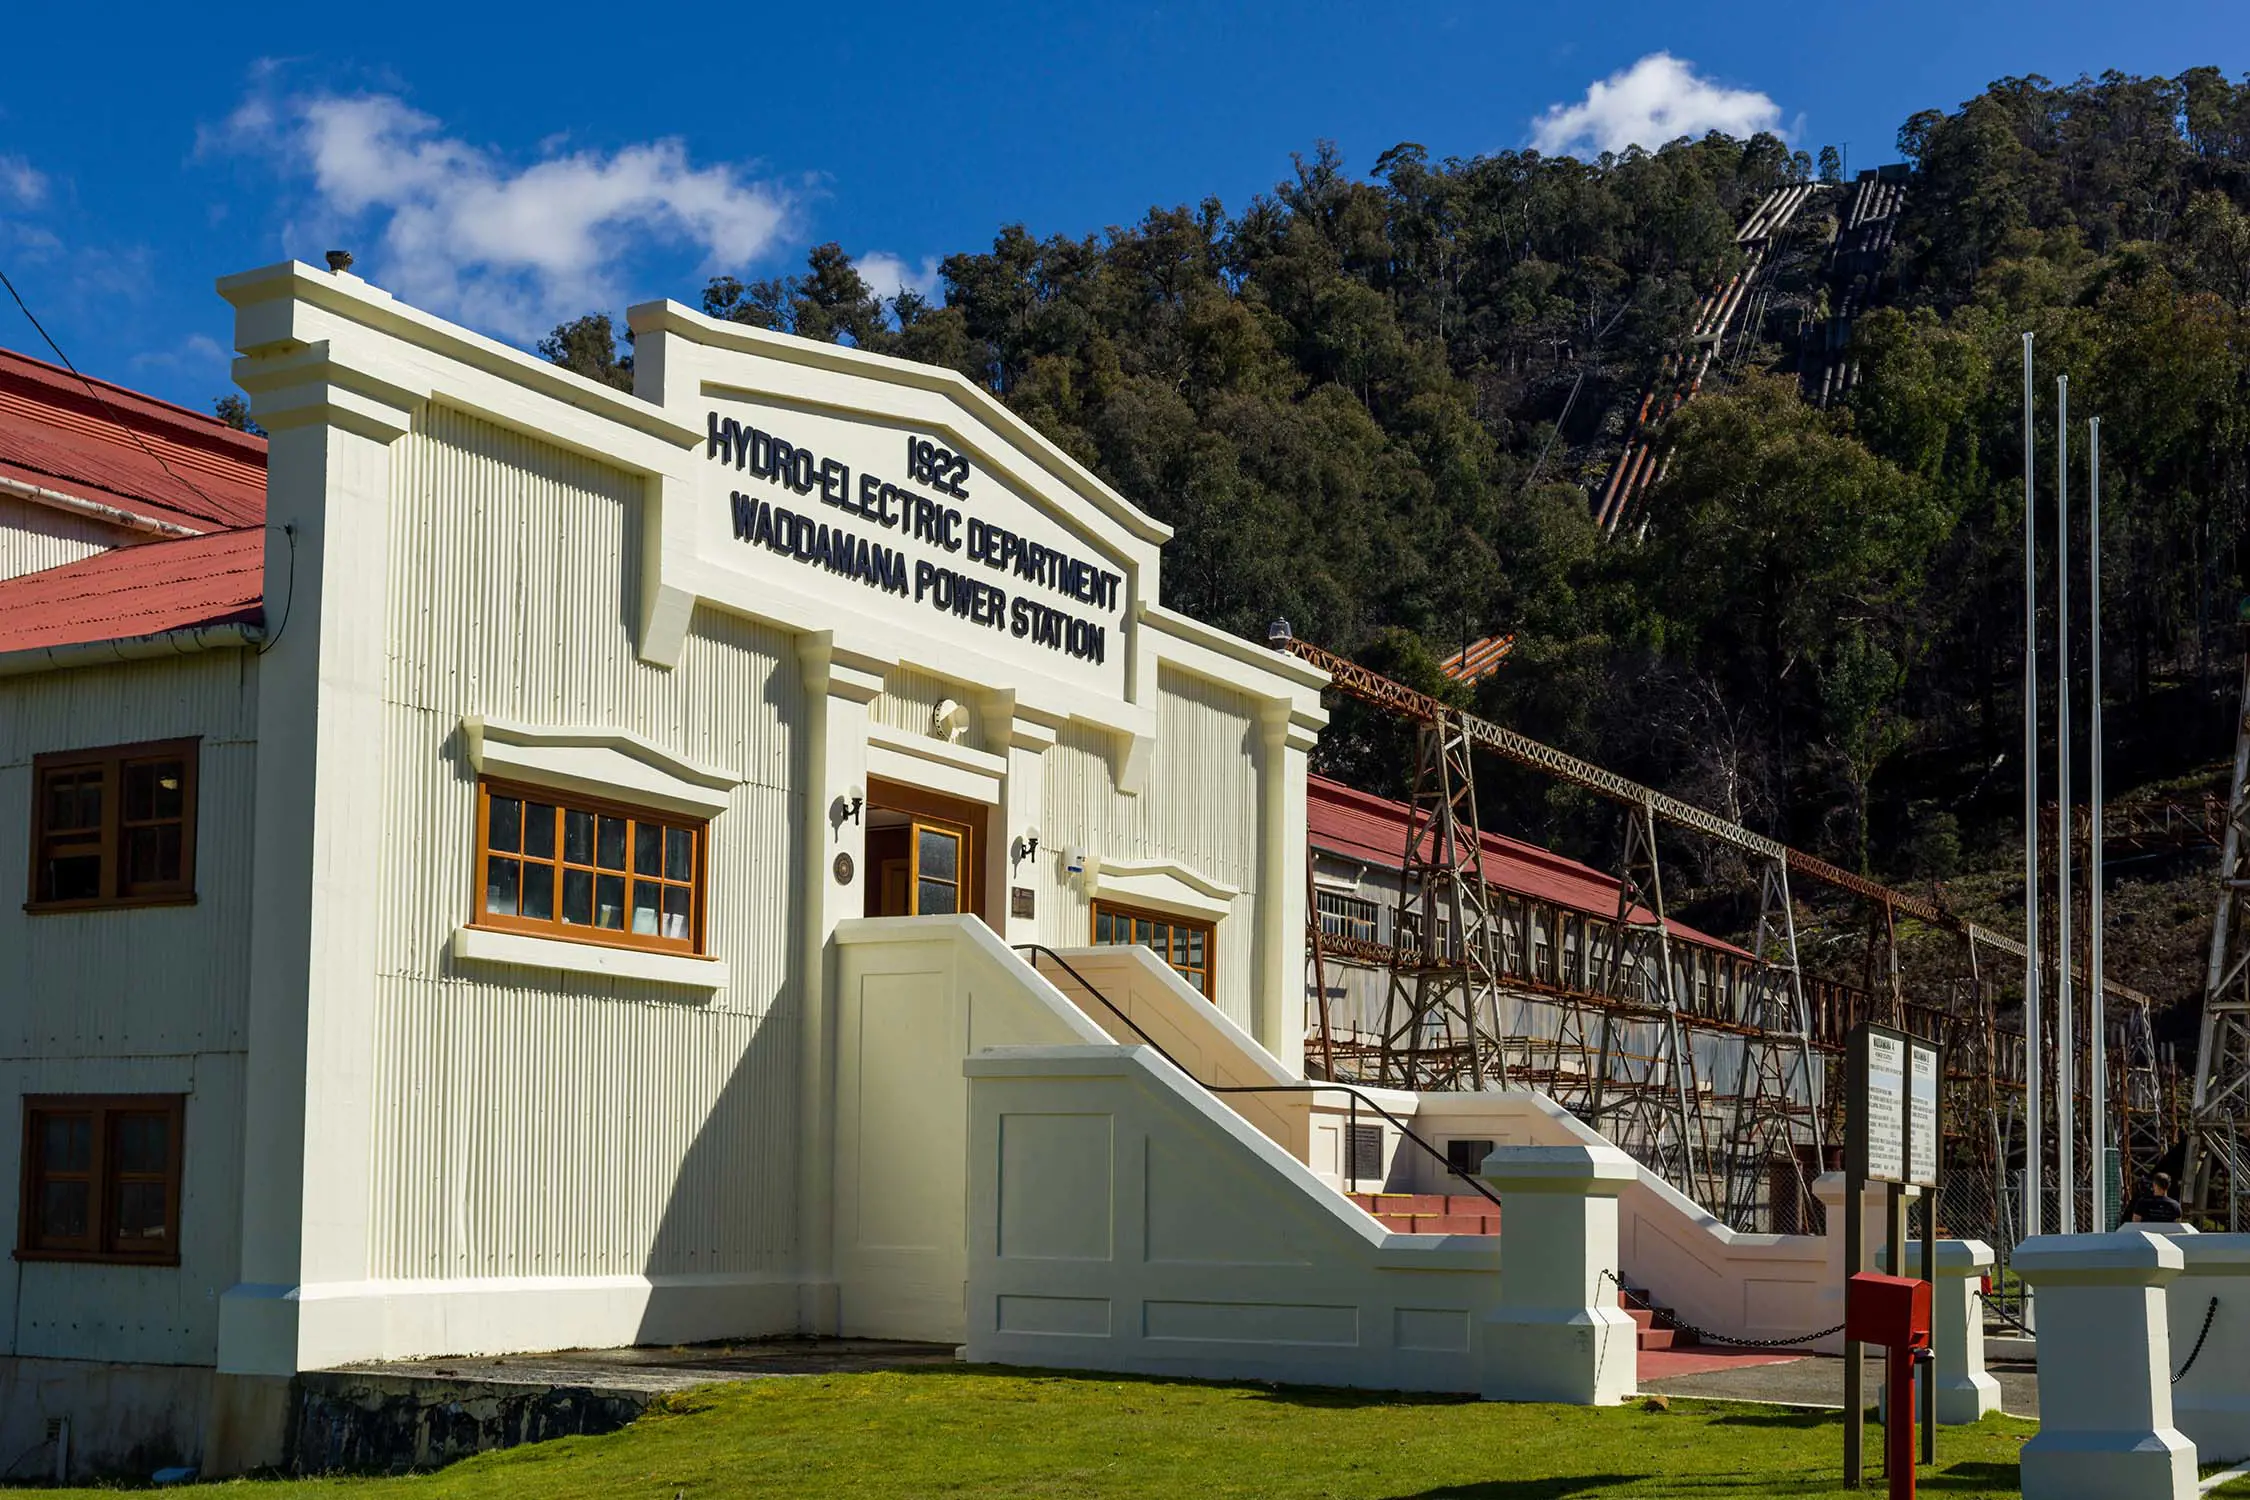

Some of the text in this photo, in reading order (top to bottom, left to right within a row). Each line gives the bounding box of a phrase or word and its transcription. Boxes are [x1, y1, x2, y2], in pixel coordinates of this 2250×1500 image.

[707, 411, 1121, 613] HYDRO-ELECTRIC DEPARTMENT
[907, 435, 970, 501] 1922
[730, 491, 1105, 666] WADDAMANA POWER STATION
